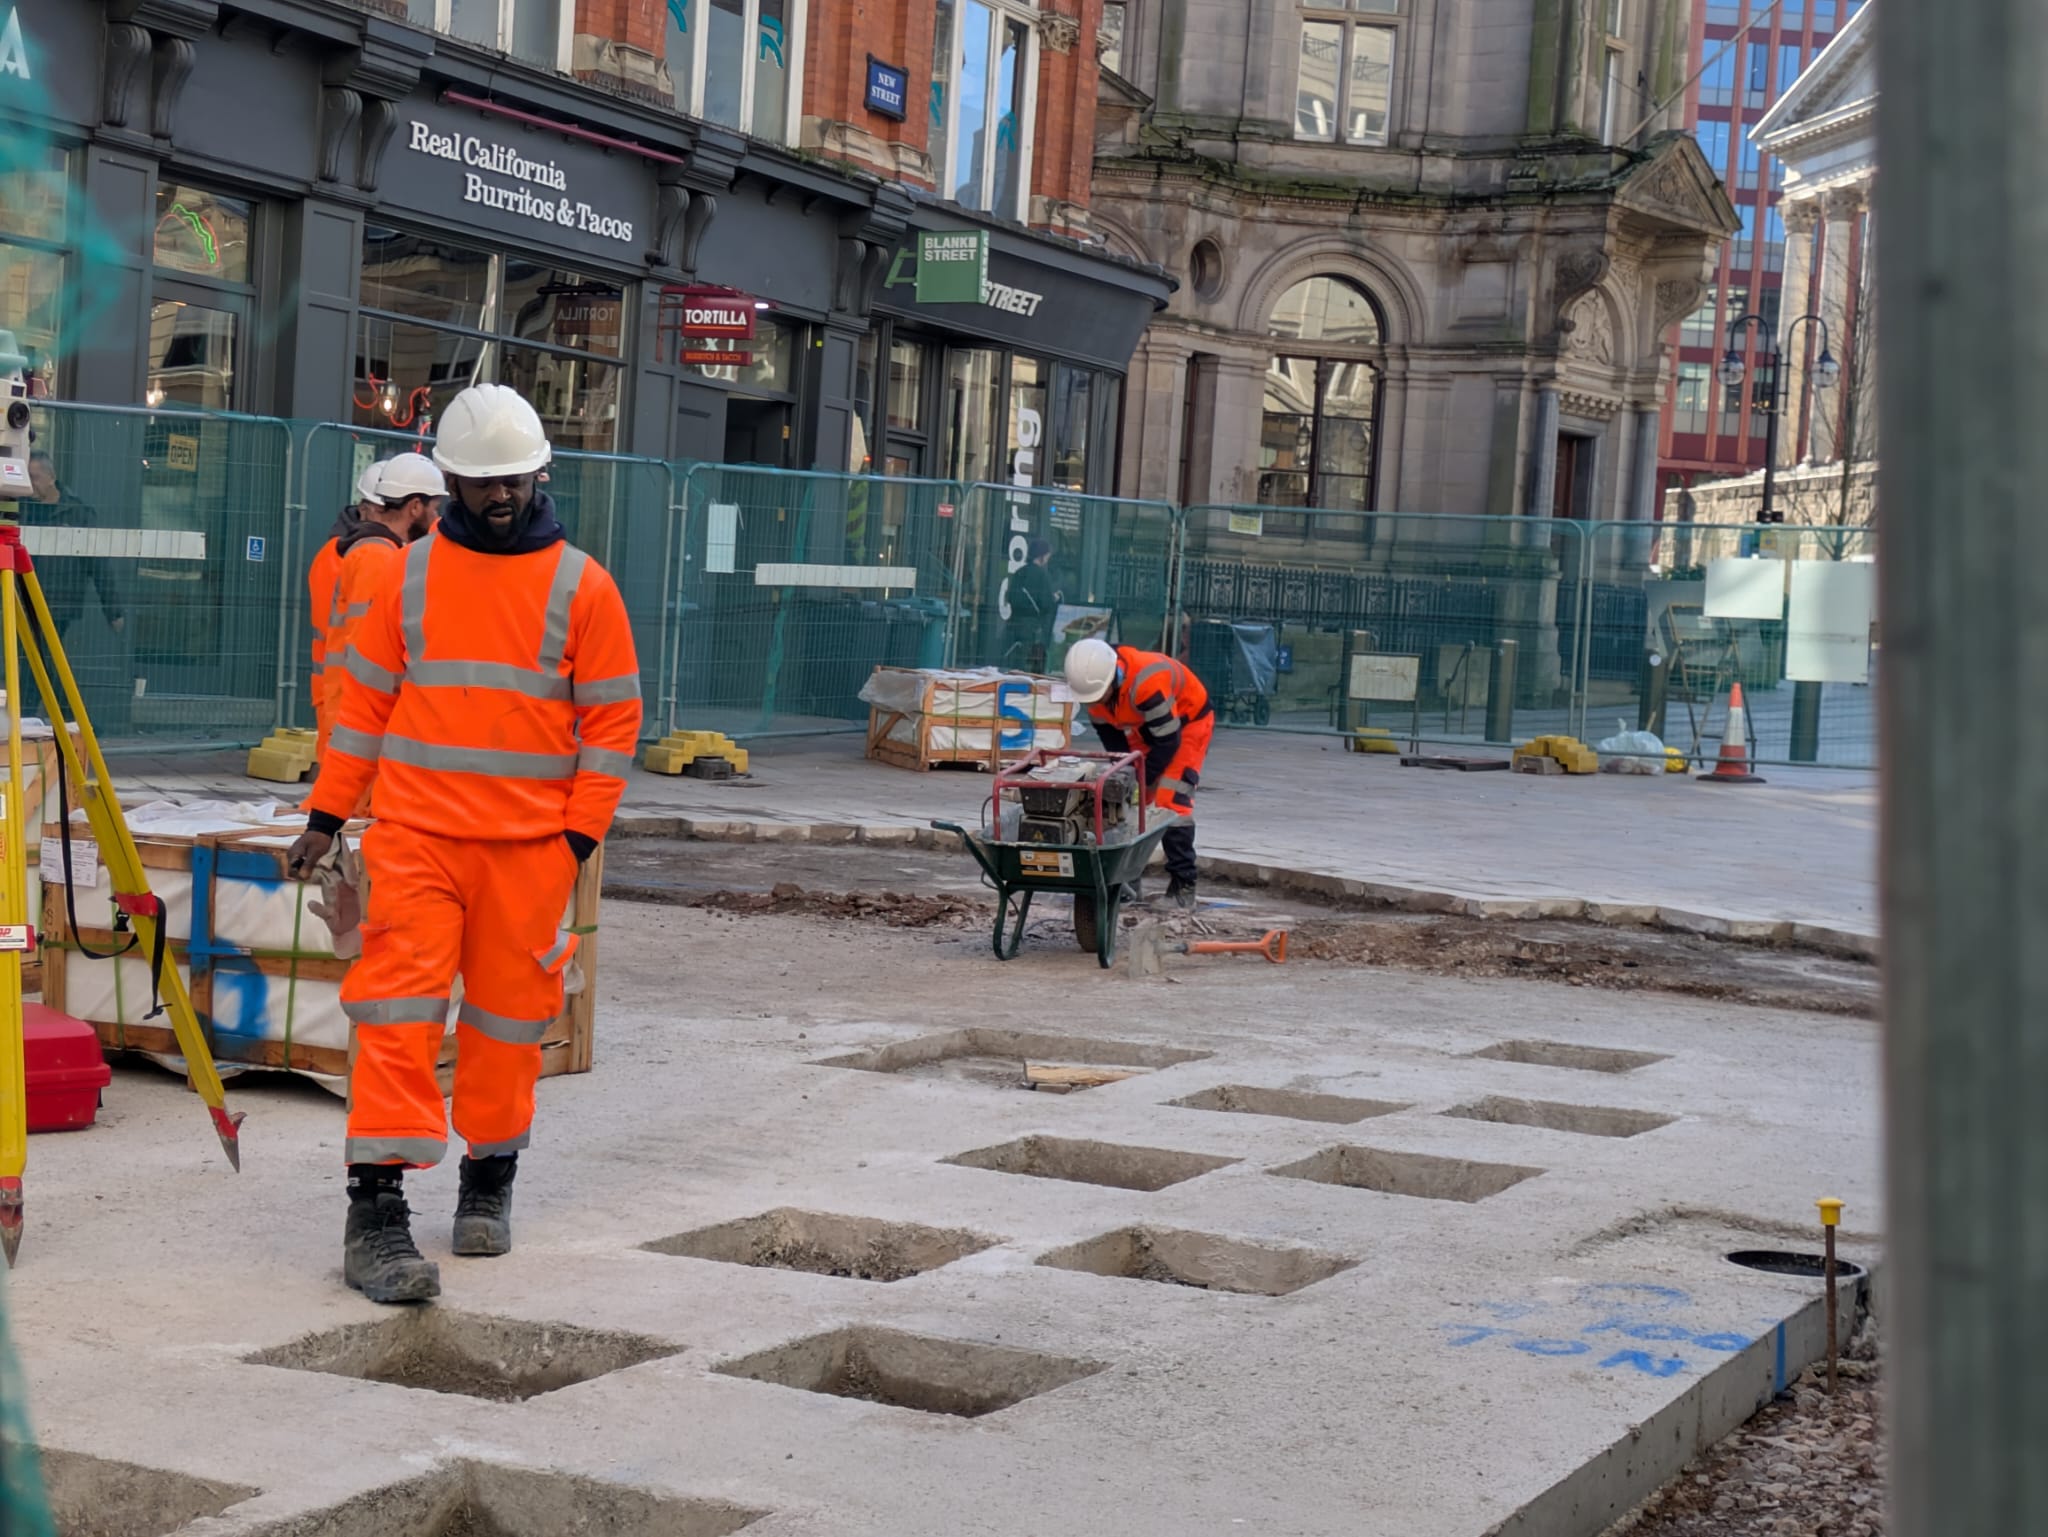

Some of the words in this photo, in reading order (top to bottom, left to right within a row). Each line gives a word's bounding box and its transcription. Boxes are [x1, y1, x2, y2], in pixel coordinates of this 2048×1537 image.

[878, 72, 897, 88] NEW
[871, 85, 901, 106] STREET
[408, 120, 461, 161] Real
[463, 136, 566, 191] California
[464, 173, 554, 222] Burritos
[556, 198, 575, 228] &
[576, 202, 633, 242] Tacos
[924, 236, 967, 249] BLANK
[924, 249, 976, 261] STREET
[684, 309, 747, 325] TORTILLA
[170, 444, 194, 465] OPEN
[997, 682, 1035, 750] 5
